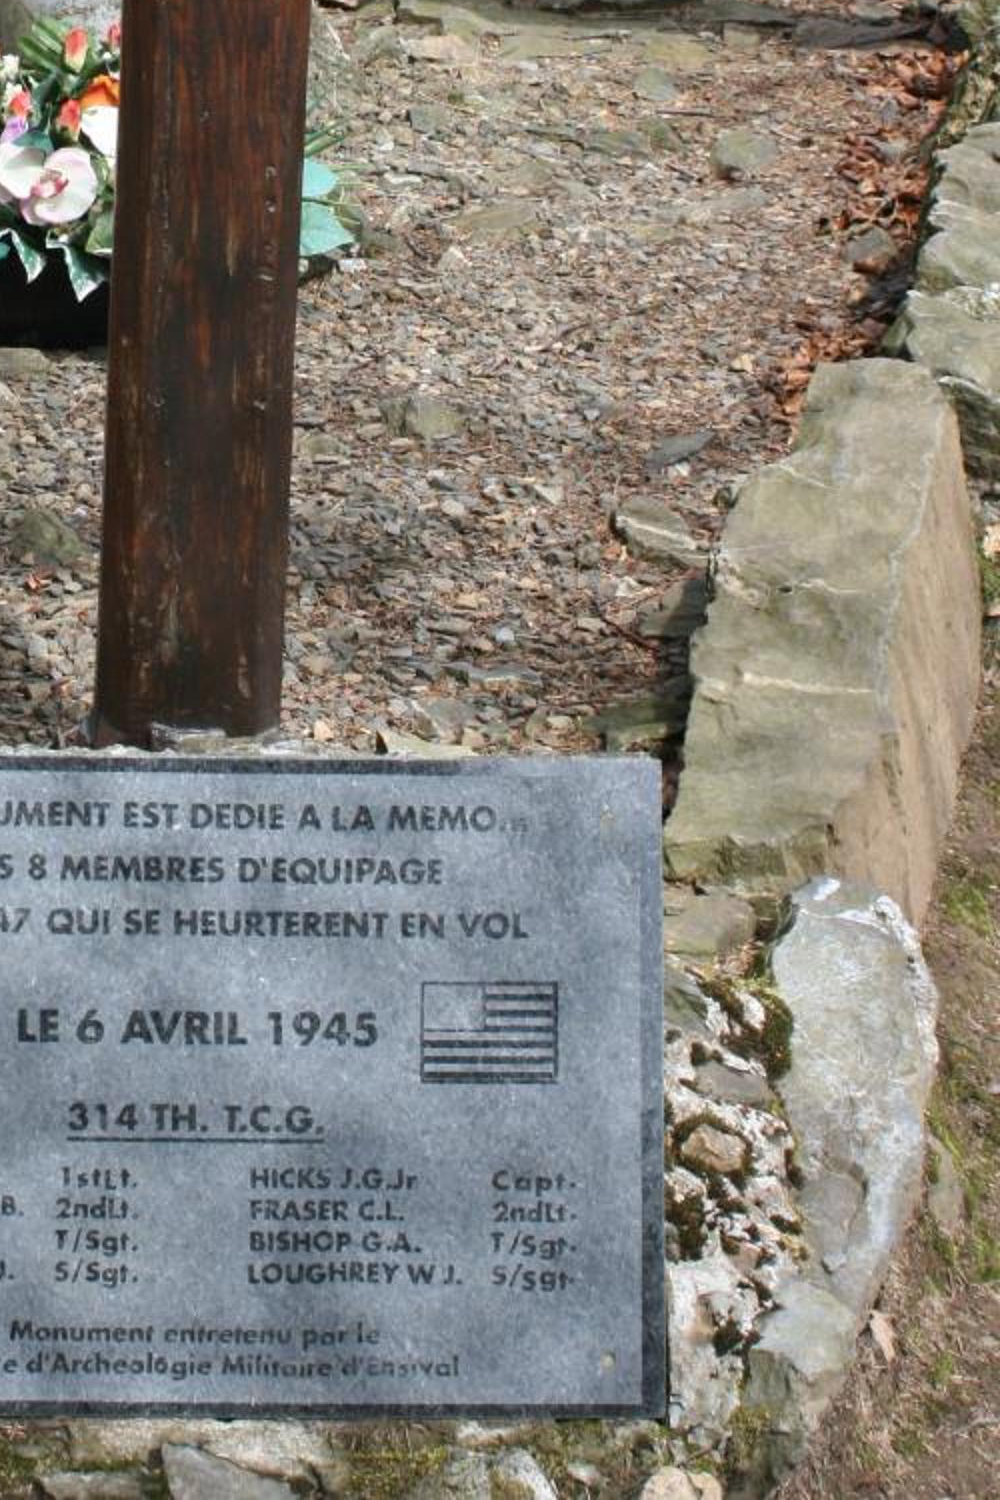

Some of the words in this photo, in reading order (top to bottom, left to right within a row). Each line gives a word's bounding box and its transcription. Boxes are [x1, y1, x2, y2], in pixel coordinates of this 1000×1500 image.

[123, 802, 178, 829] EST
[189, 803, 285, 830] DEDIE
[299, 804, 322, 830] A
[331, 805, 376, 831] LA
[27, 853, 47, 881] 8
[60, 854, 225, 883] MEMBRES
[237, 856, 443, 885] D'EQUIPAGE
[47, 908, 110, 935] QUI
[123, 909, 160, 936] SE
[173, 910, 389, 938] HEURTERENT
[401, 911, 446, 939] EN
[458, 912, 529, 940] VOL
[17, 1008, 60, 1043] LE
[76, 1009, 105, 1045] 6
[120, 1010, 249, 1046] AVRIL
[268, 1011, 378, 1047] 1945
[250, 1167, 332, 1190] HICKS
[491, 1169, 577, 1197] Capt.
[249, 1199, 348, 1222] FRASER
[248, 1230, 352, 1253] BISHOP
[247, 1262, 400, 1285] LOUGHREY
[8, 1320, 155, 1343] Monument
[164, 1324, 292, 1346] entretenu
[302, 1327, 348, 1352] par
[356, 1321, 381, 1345] le
[221, 1354, 333, 1377] Militaire
